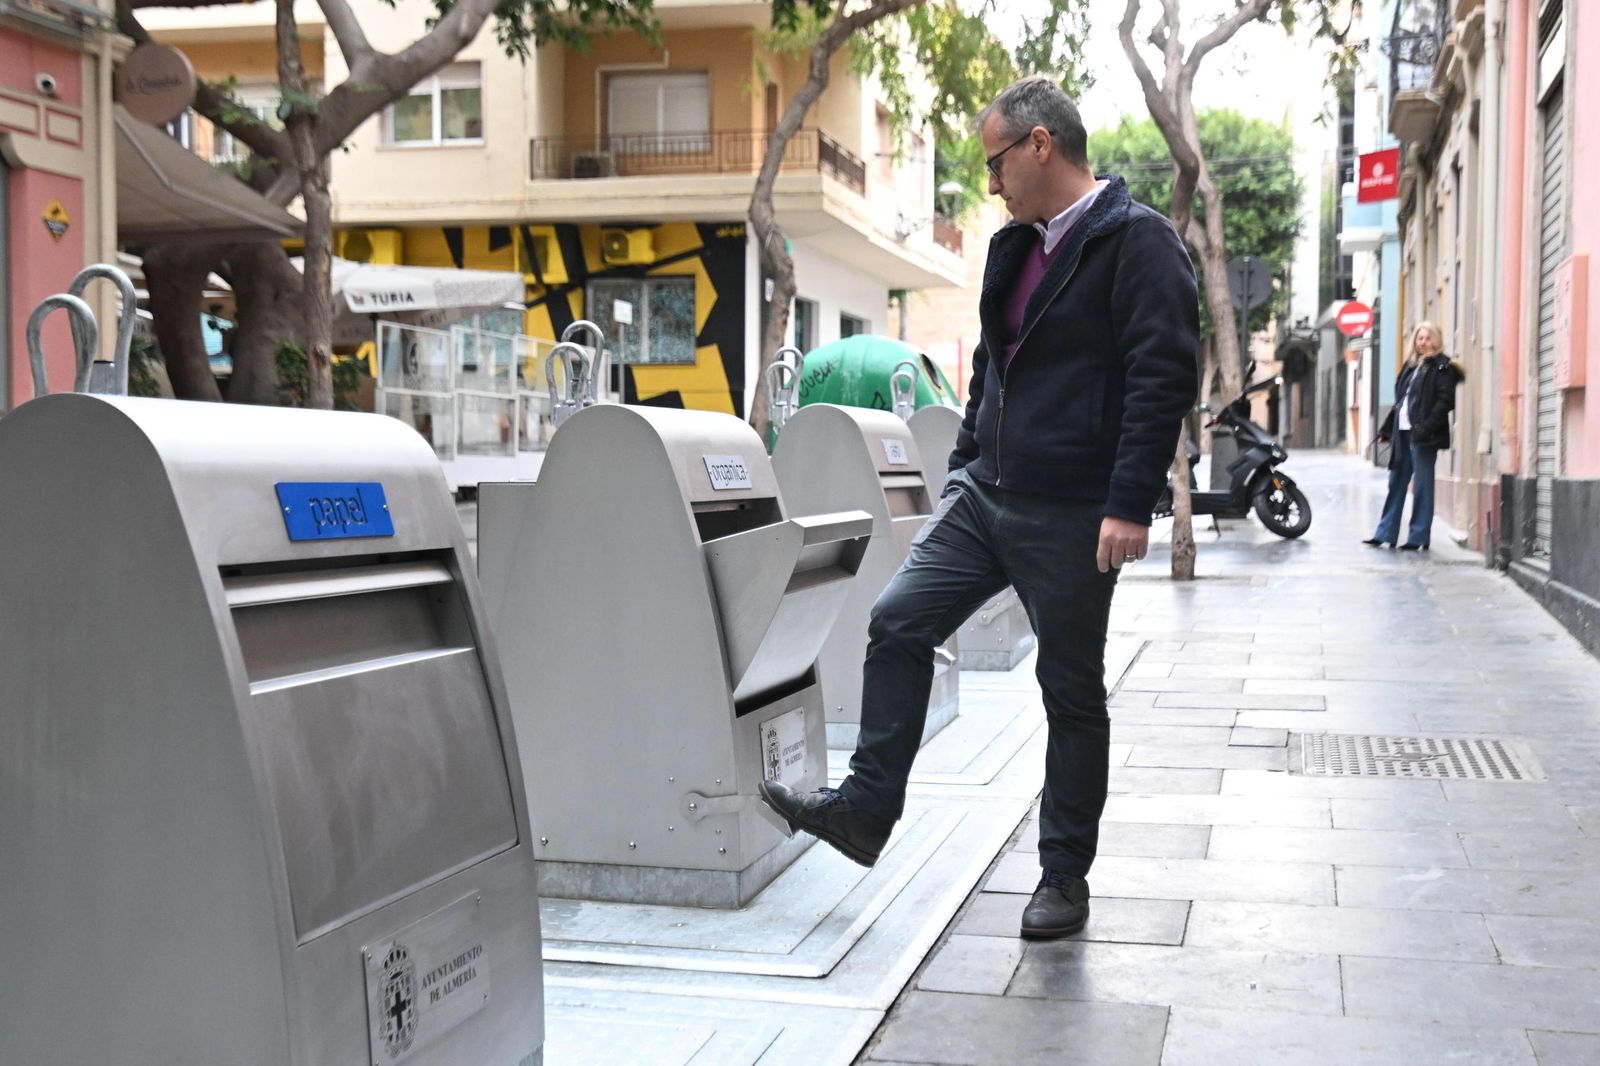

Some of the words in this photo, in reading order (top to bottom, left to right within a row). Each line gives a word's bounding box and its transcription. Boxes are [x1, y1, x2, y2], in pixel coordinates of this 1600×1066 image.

[370, 292, 415, 305] TURIA
[308, 487, 369, 535] papel
[421, 944, 482, 990] AYUNTAMIENTO
[430, 990, 441, 1005] DE
[443, 966, 477, 997] ALMERÍA
